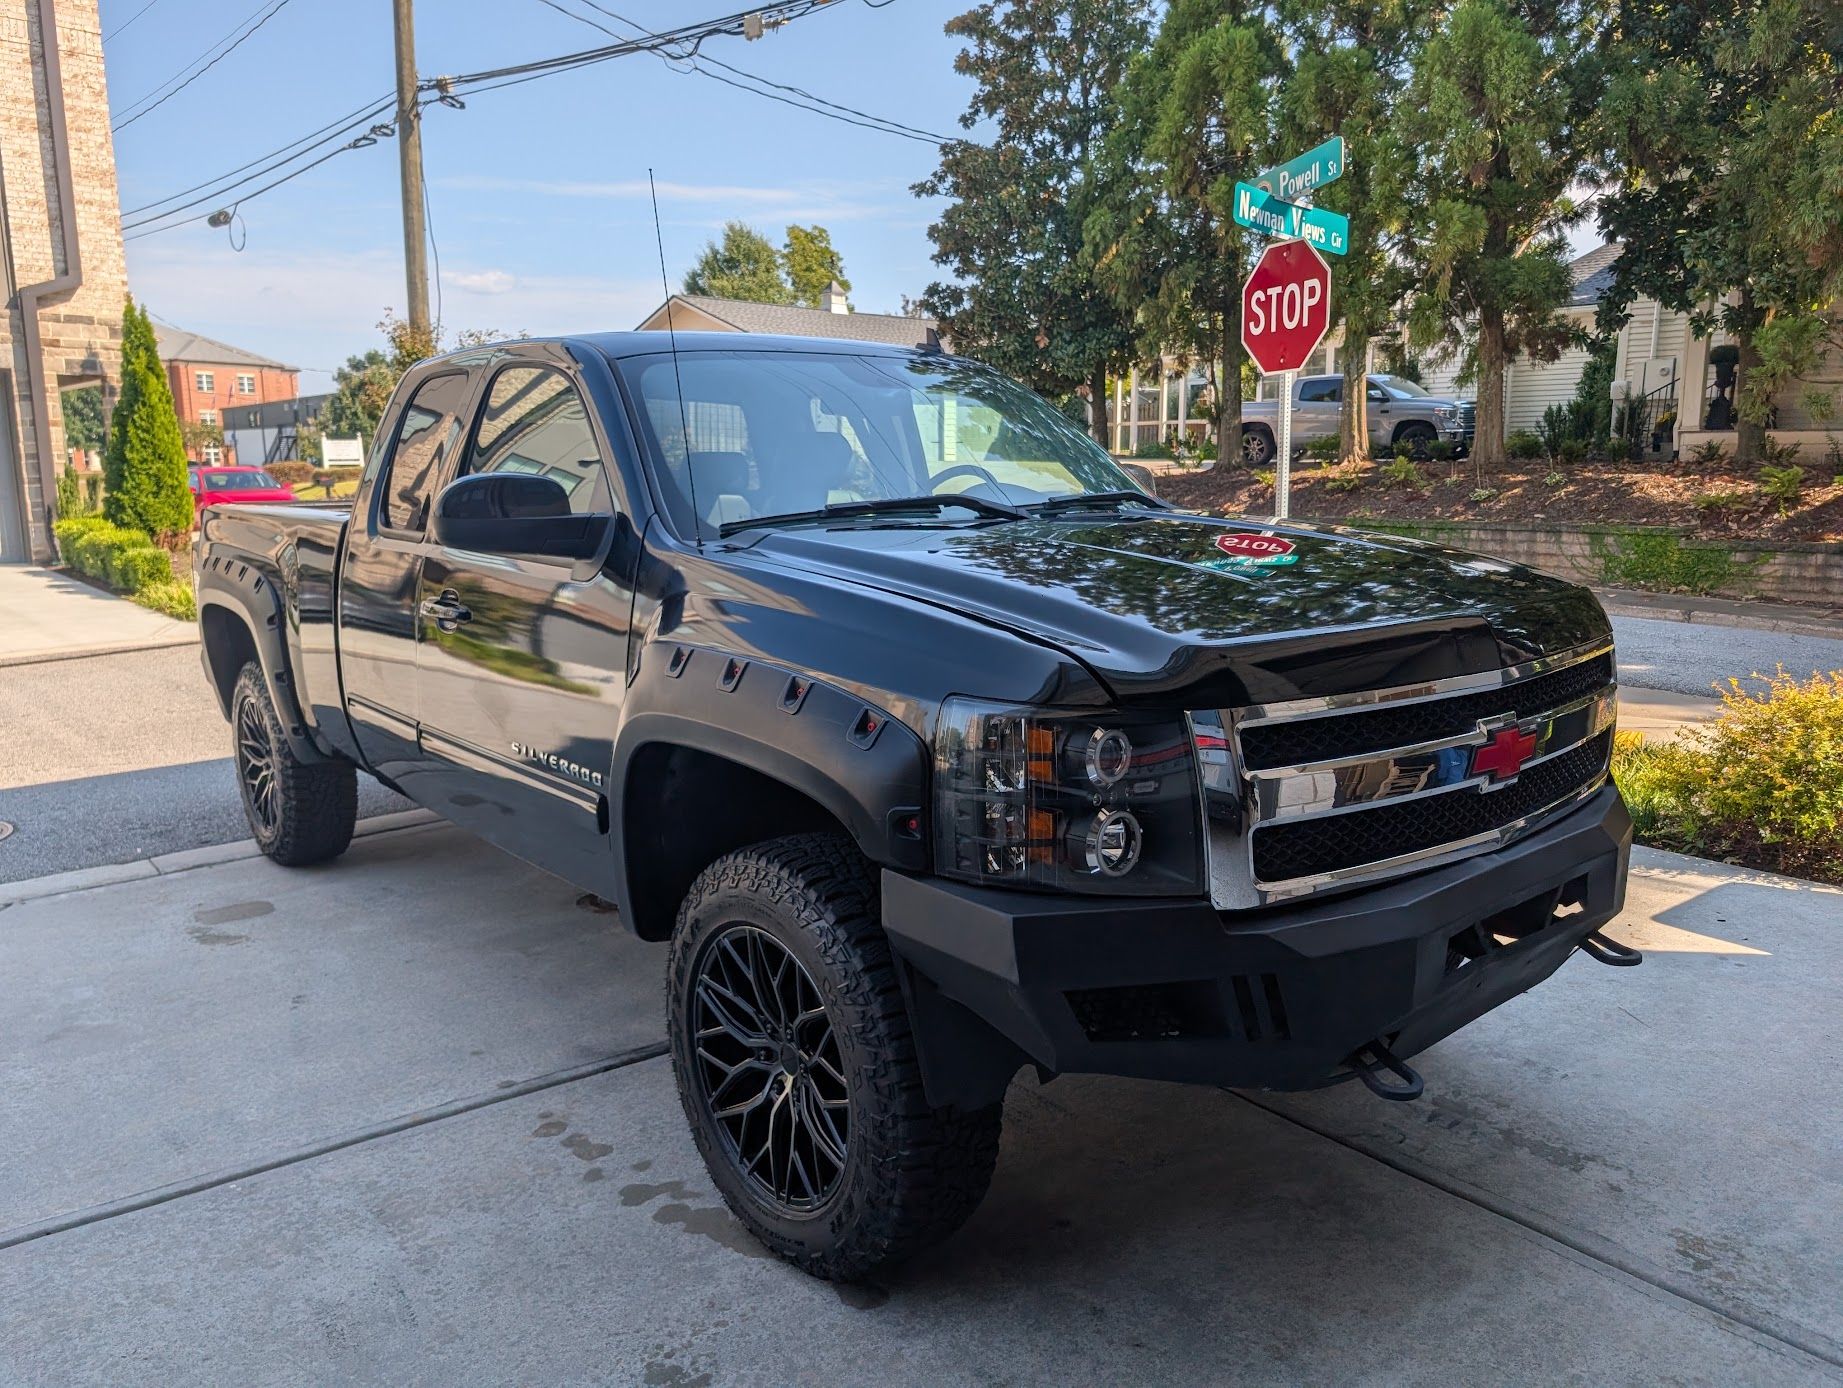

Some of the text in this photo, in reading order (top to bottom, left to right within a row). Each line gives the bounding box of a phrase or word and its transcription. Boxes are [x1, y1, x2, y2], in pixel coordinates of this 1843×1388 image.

[1280, 161, 1337, 197] Powell St
[1239, 190, 1342, 249] Newnan Views Cir
[1249, 278, 1321, 336] STOP
[511, 741, 603, 787] SILVERADO
